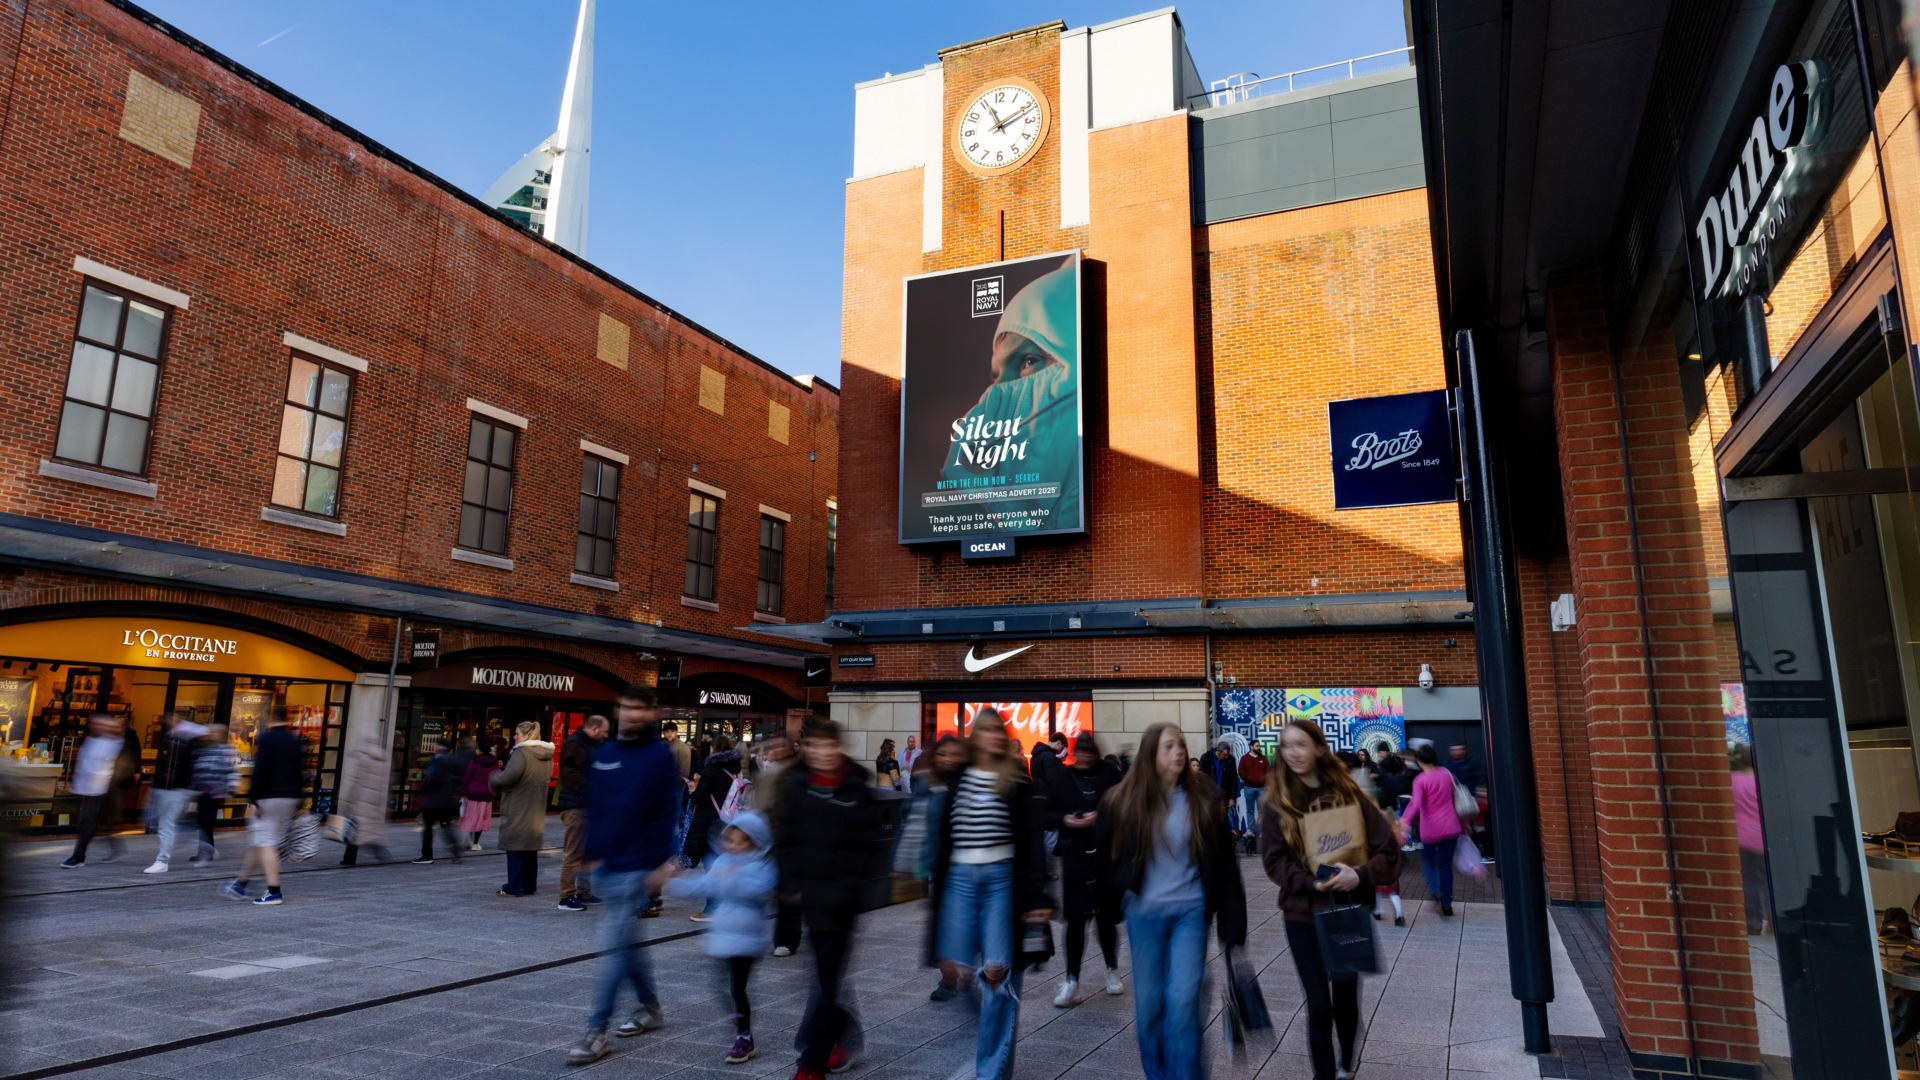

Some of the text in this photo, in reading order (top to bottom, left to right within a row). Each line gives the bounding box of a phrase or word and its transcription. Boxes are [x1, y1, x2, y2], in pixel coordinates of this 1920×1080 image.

[994, 91, 1005, 104] 12
[1012, 93, 1018, 103] 1
[980, 99, 990, 110] 11
[968, 113, 980, 123] 10
[1025, 116, 1035, 124] 3
[969, 143, 979, 152] 8
[1010, 144, 1019, 154] 5
[981, 150, 990, 160] 7
[996, 151, 1003, 161] 6
[1696, 63, 1799, 301] Dune
[1737, 196, 1788, 297] LONDON
[976, 295, 999, 304] ROYAL
[976, 301, 998, 310] NAVY
[950, 413, 1024, 442] Silent
[953, 435, 1030, 470] Night
[1344, 428, 1423, 471] Boots
[1401, 460, 1421, 468] Since
[936, 479, 958, 489] WATCH
[959, 478, 971, 487] THE
[973, 476, 989, 486] FILM
[991, 475, 1006, 485] NOW
[1015, 472, 1040, 483] SEARCH
[948, 493, 968, 501] NAVY
[968, 490, 1008, 500] CHRISTMAS
[1008, 488, 1037, 497] ADVERT
[928, 508, 1050, 524] Thank you to everyone who
[932, 517, 1045, 533] keeps us safe, every day.
[970, 542, 1006, 552] OCEAN
[122, 628, 238, 655] L'OCCITANE
[145, 649, 215, 662] EN PROVENCE
[472, 667, 574, 691] MOLTON BROWN
[709, 691, 751, 706] SWAROVSKI
